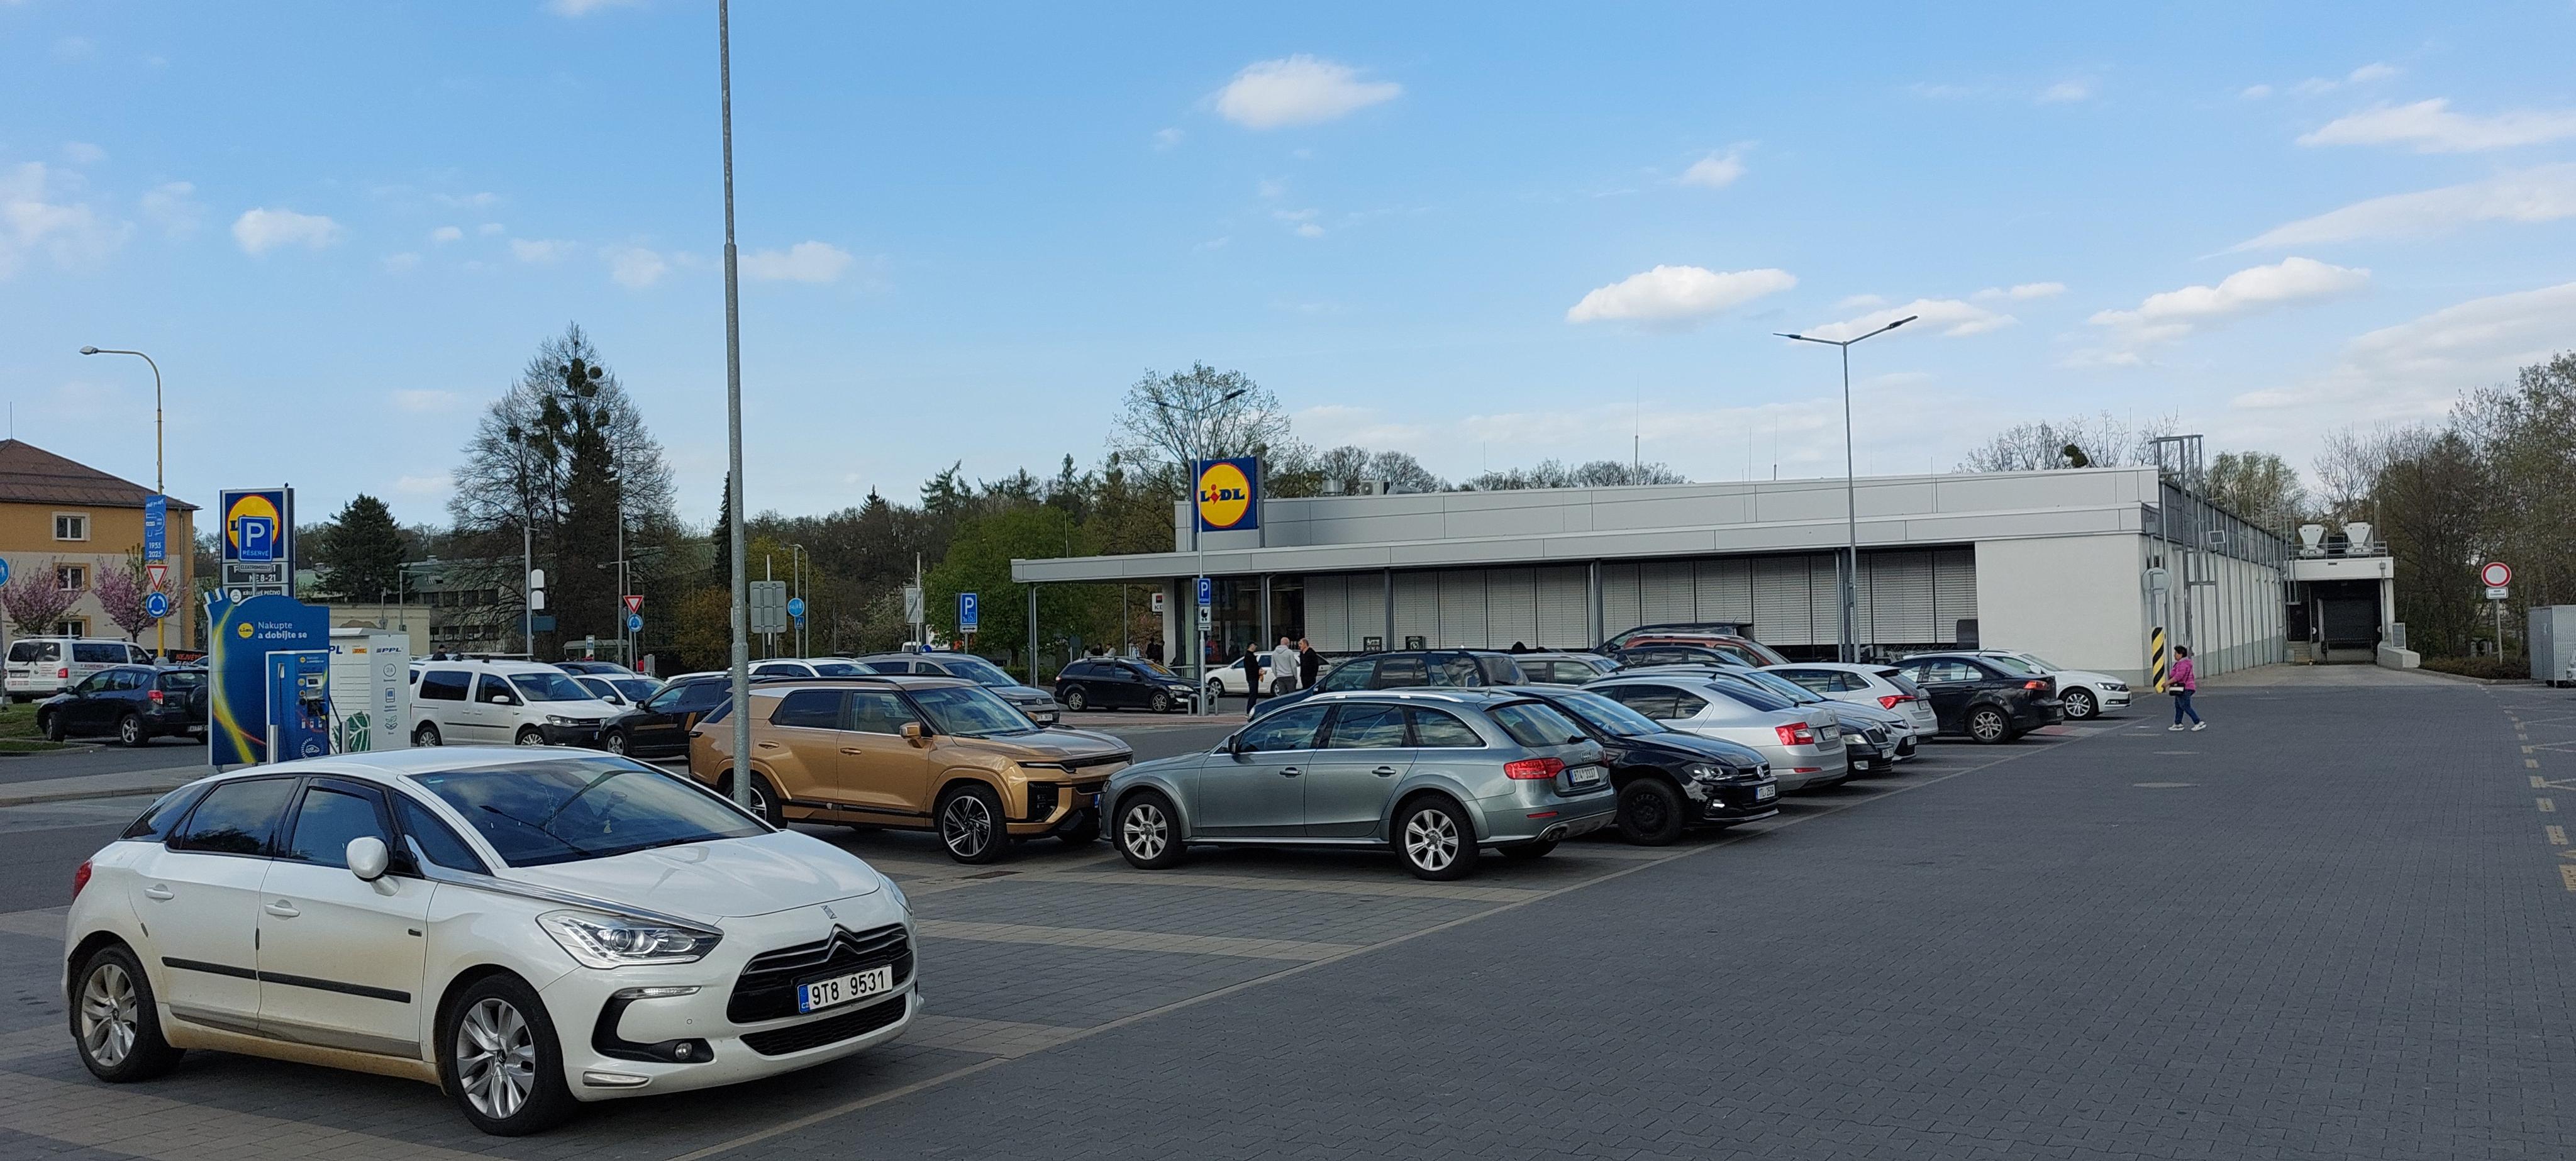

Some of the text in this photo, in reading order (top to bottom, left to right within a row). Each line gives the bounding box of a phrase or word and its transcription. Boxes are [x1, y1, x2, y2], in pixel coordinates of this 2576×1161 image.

[246, 522, 265, 548] P
[260, 574, 276, 582] 8-21
[1201, 582, 1208, 597] P
[965, 597, 974, 615] P
[258, 621, 293, 630] Nakupte
[265, 630, 296, 640] dobijte
[329, 645, 343, 655] PL
[812, 970, 884, 1005] 9T8 9531
